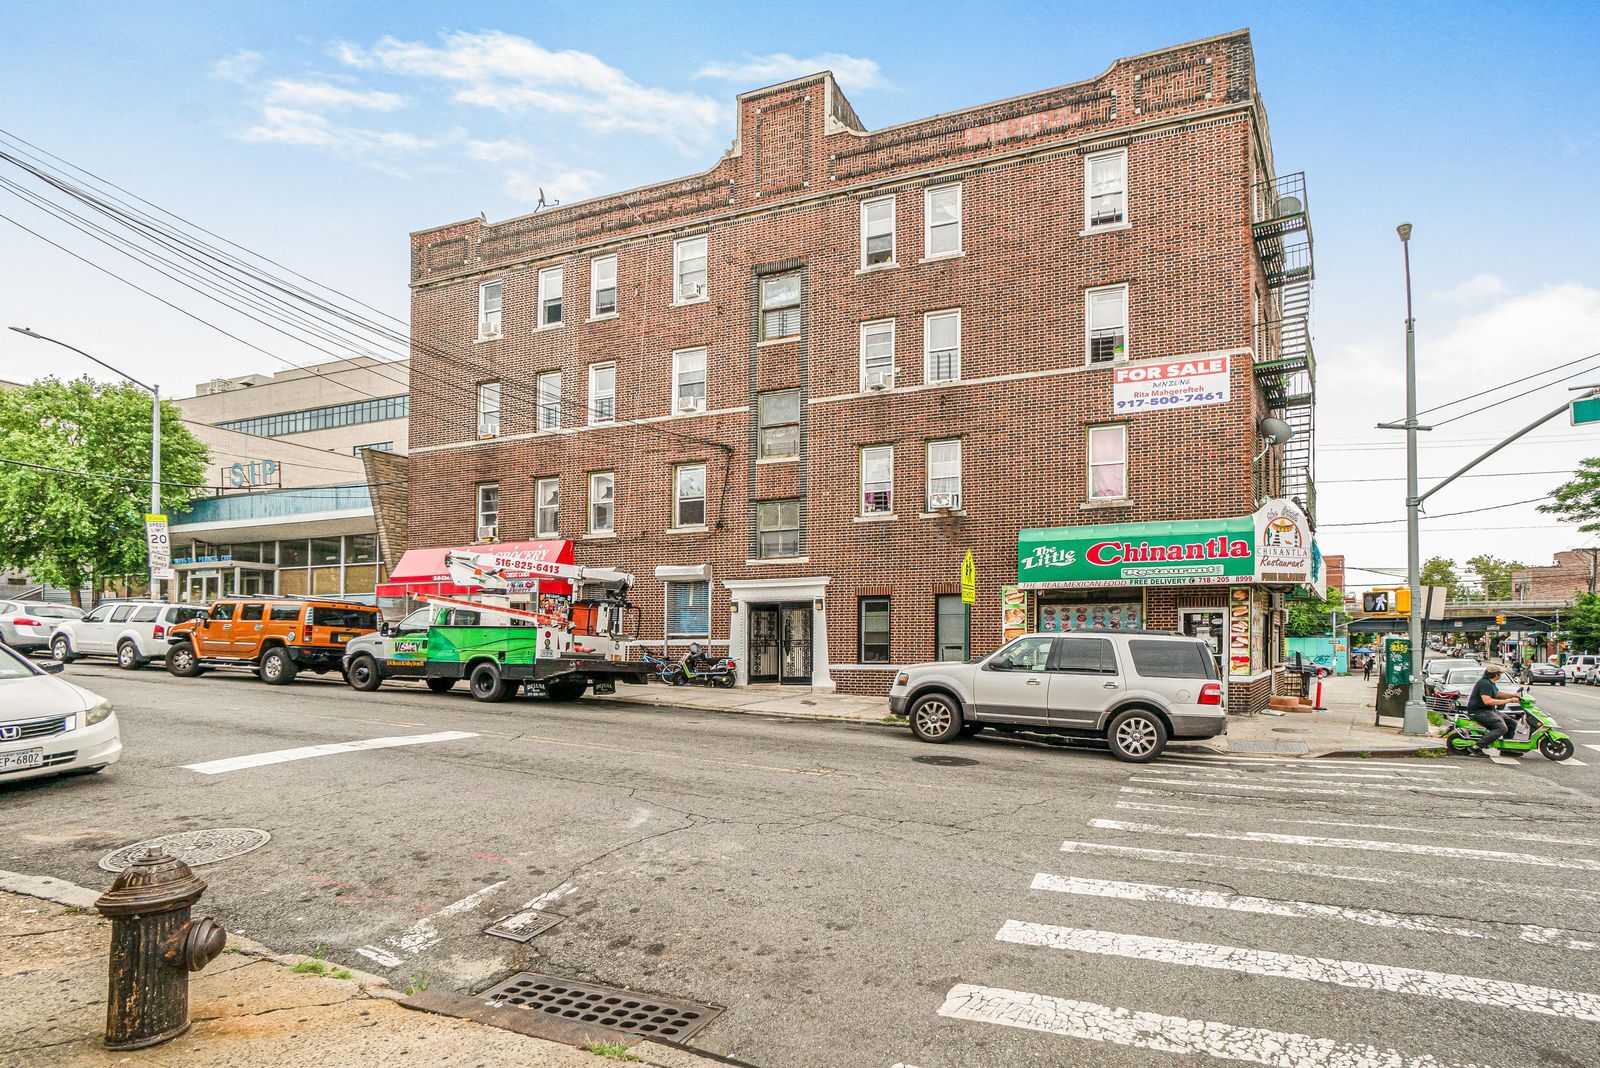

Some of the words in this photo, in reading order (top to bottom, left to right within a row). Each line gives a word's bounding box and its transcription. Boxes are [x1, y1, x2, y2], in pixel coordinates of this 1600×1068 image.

[1117, 367, 1162, 383] FOR
[1167, 360, 1223, 379] SALE
[1133, 391, 1150, 399] Rita
[1151, 385, 1205, 398] Mahgerefteh
[1116, 391, 1224, 409] 917-500-7461
[231, 459, 276, 487] SIP
[150, 534, 167, 544] 20
[1032, 545, 1057, 558] The
[1085, 535, 1252, 567] Chinantla
[1256, 548, 1309, 557] CHINANTLA
[1021, 549, 1077, 570] Little
[1259, 554, 1305, 568] Restaurant
[1123, 566, 1216, 577] Restaurant
[1023, 581, 1038, 589] THE
[1063, 580, 1101, 588] MEXICAN
[1103, 579, 1127, 587] FOOD
[1150, 577, 1187, 585] DELIVERY
